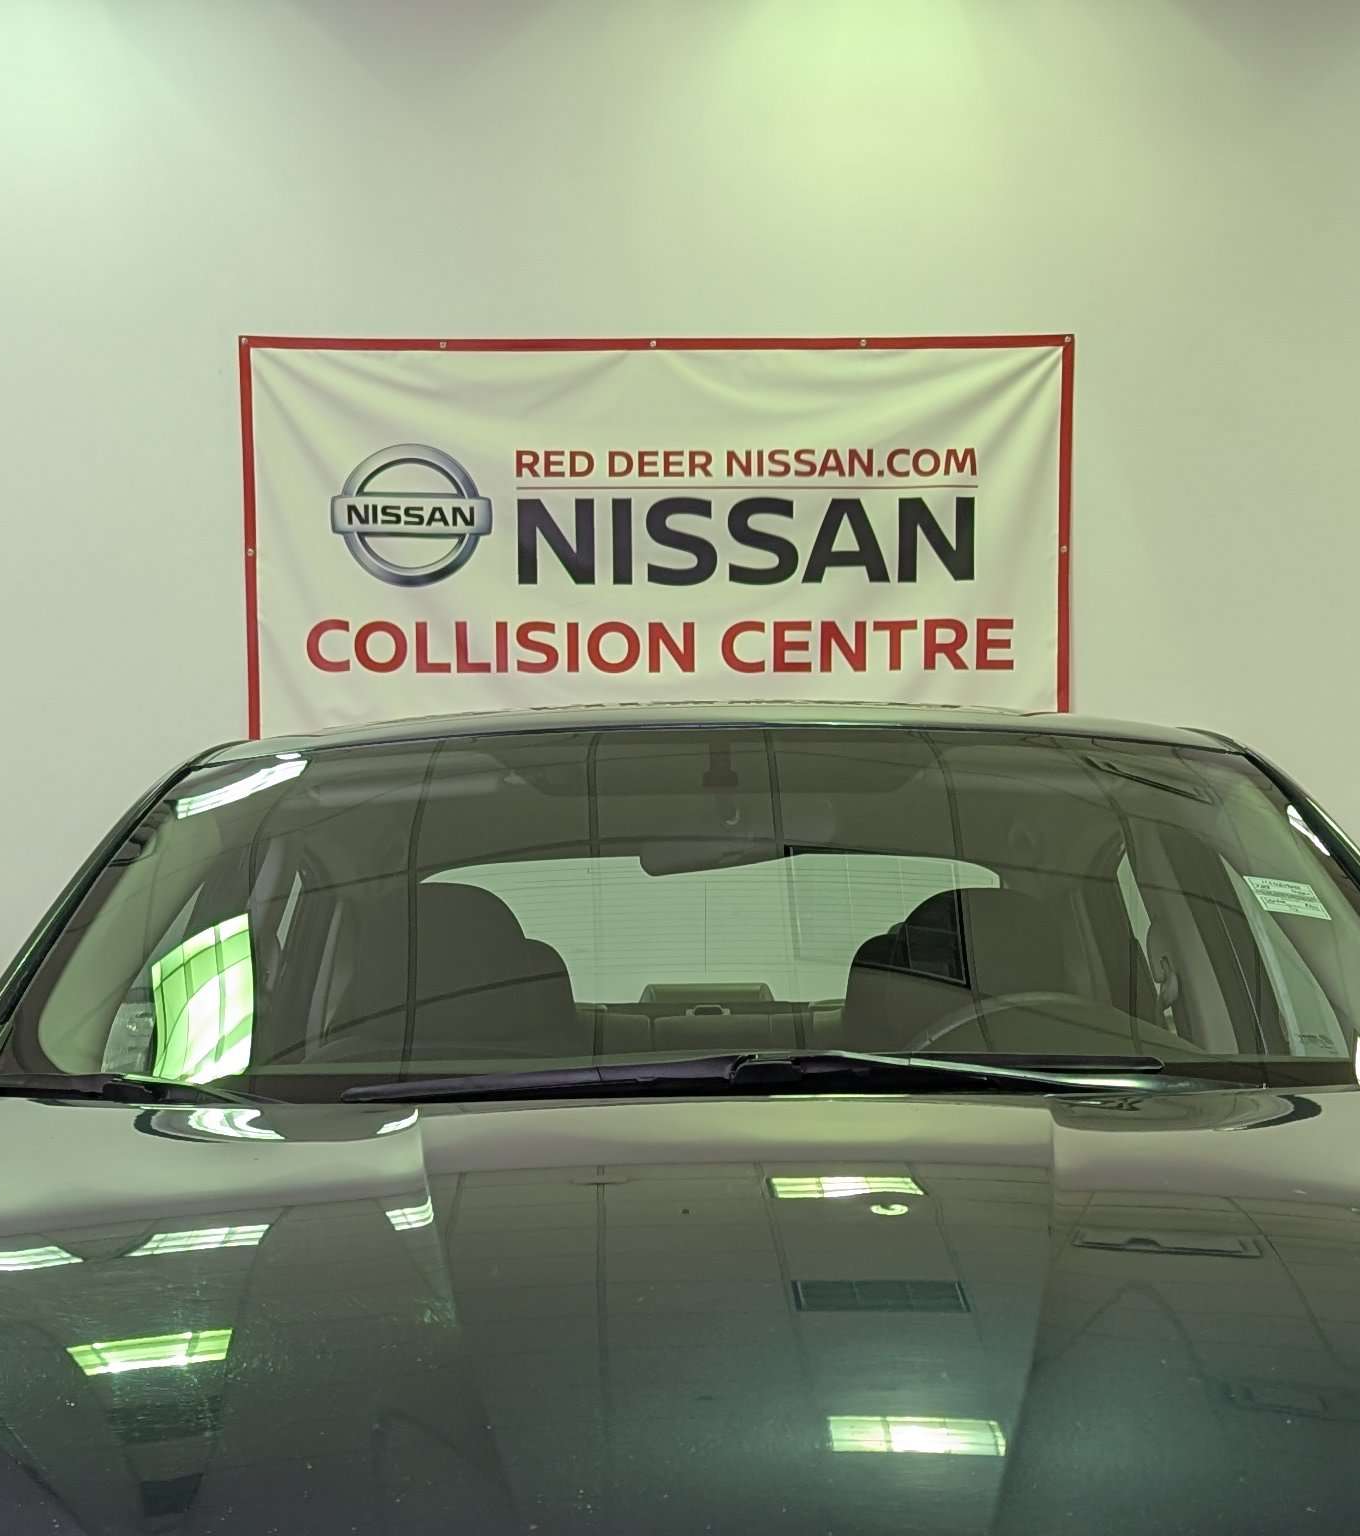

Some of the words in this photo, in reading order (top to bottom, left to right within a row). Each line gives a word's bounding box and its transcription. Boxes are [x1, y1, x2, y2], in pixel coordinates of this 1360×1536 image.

[516, 449, 595, 478] RED
[608, 448, 714, 478] DEER
[726, 447, 978, 478] NISSAN.COM
[346, 503, 475, 527] NISSAN
[517, 496, 976, 586] NISSAN
[306, 618, 696, 674] COLLISION
[722, 617, 1015, 673] CENTRE
